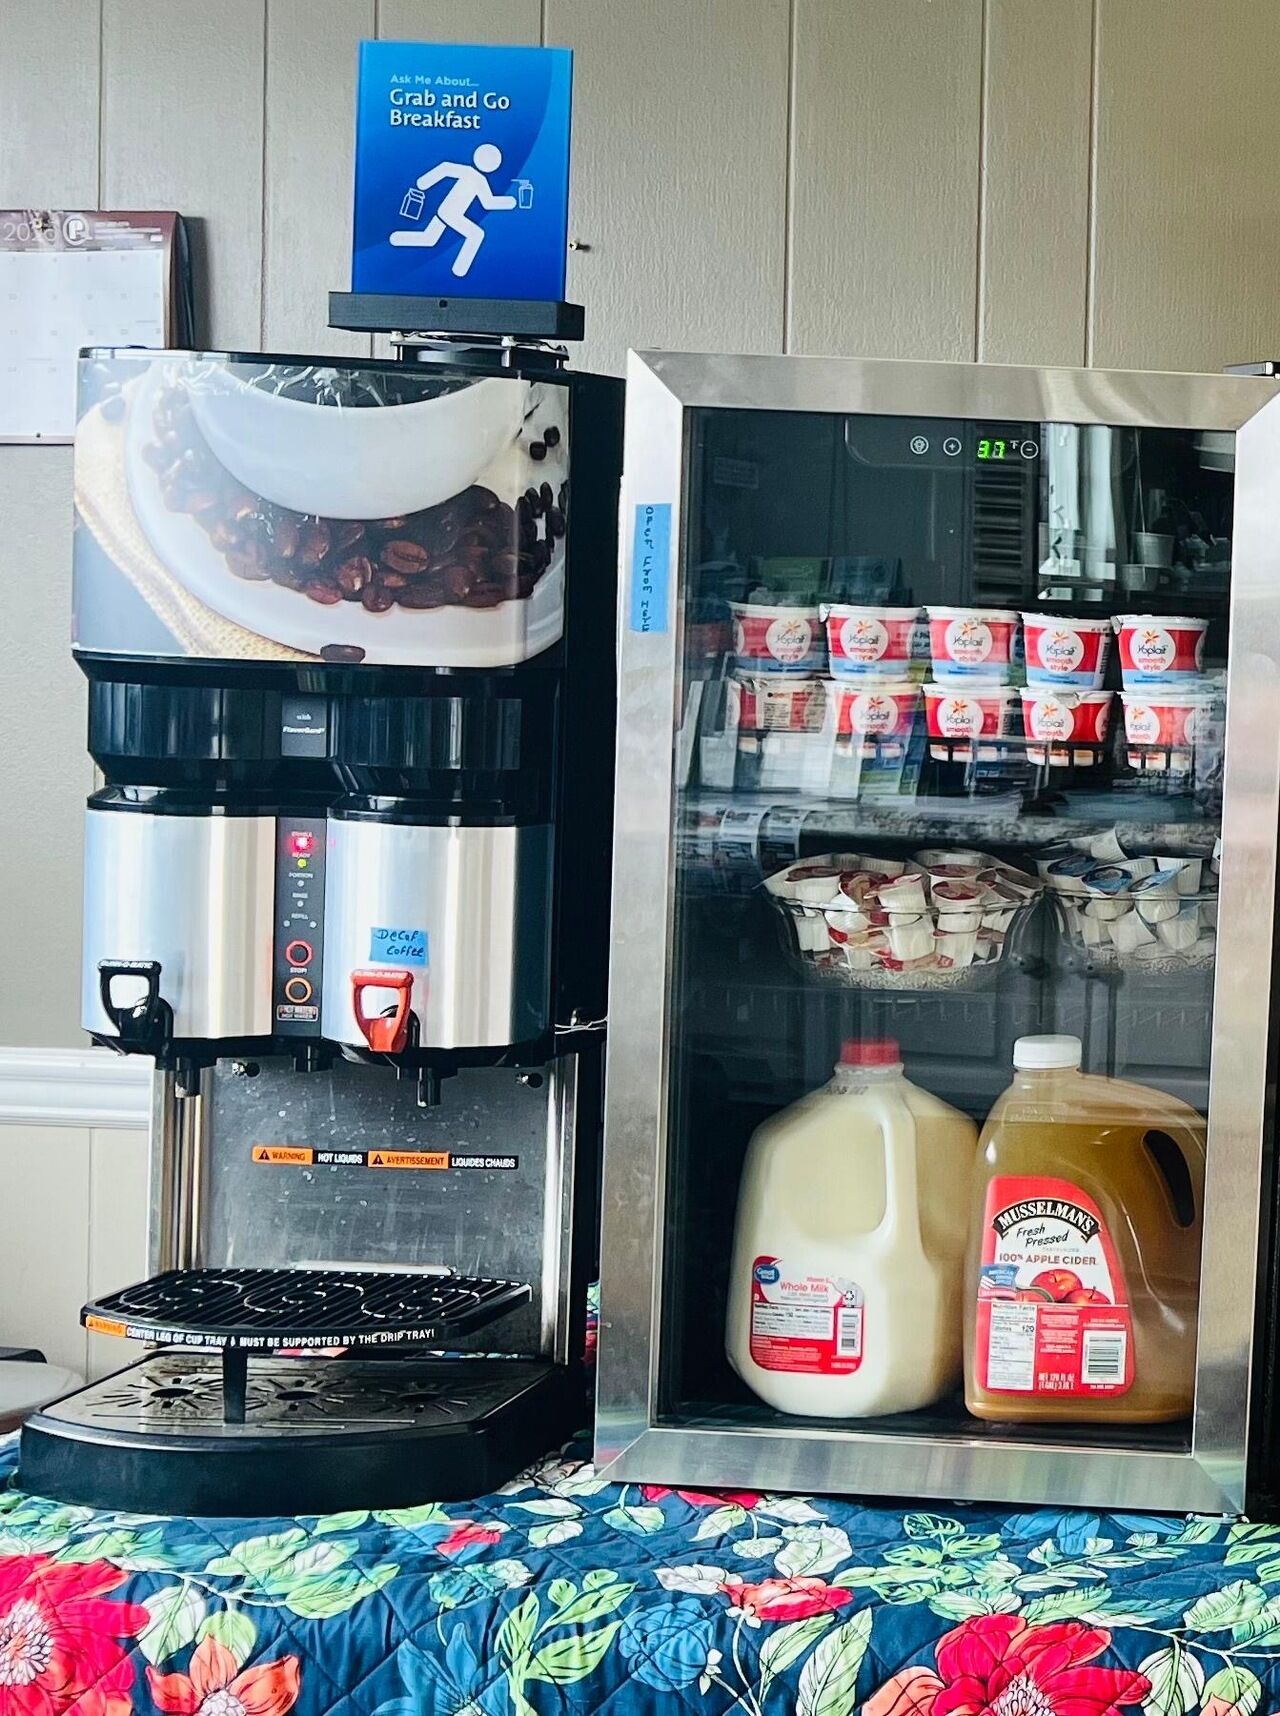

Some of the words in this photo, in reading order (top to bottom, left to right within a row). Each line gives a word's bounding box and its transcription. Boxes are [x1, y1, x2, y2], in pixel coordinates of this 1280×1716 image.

[390, 74, 412, 84] Ask
[415, 75, 431, 85] Me
[390, 88, 436, 107] Grab
[441, 91, 478, 109] and
[483, 92, 510, 110] Go
[390, 108, 481, 130] Breakfast
[953, 637, 985, 648] Yoplait
[1046, 645, 1077, 656] Yoplait
[1137, 645, 1168, 657] Yoplait
[376, 929, 419, 942] Decaf
[386, 945, 425, 957] Coffee
[272, 1151, 306, 1161] WARNING
[317, 1153, 333, 1163] HOT
[334, 1153, 363, 1164] LIQUIDS
[386, 1156, 445, 1166] AVERTISSEMENT
[451, 1157, 485, 1168] LIQUIDES
[485, 1158, 516, 1168] CHAUDS
[997, 1201, 1095, 1232] MUSSELMAN'S
[1016, 1222, 1046, 1238] Fresh
[1025, 1229, 1070, 1247] Pressed
[1026, 1254, 1060, 1264] APPLE
[1062, 1256, 1097, 1266] CIDER
[780, 1281, 808, 1292] Whole
[811, 1283, 829, 1293] Milk
[126, 1325, 155, 1340] CENTER
[155, 1332, 172, 1343] LEG
[173, 1332, 184, 1344] OF
[185, 1334, 203, 1345] CUP
[205, 1335, 227, 1347] TRAY
[240, 1336, 264, 1347] MUST
[267, 1337, 280, 1347] BE
[282, 1336, 340, 1348] SUPPORTED
[342, 1335, 355, 1346] BY
[359, 1333, 378, 1344] THE
[380, 1331, 404, 1343] DRIP
[407, 1328, 435, 1340] TRAY!
